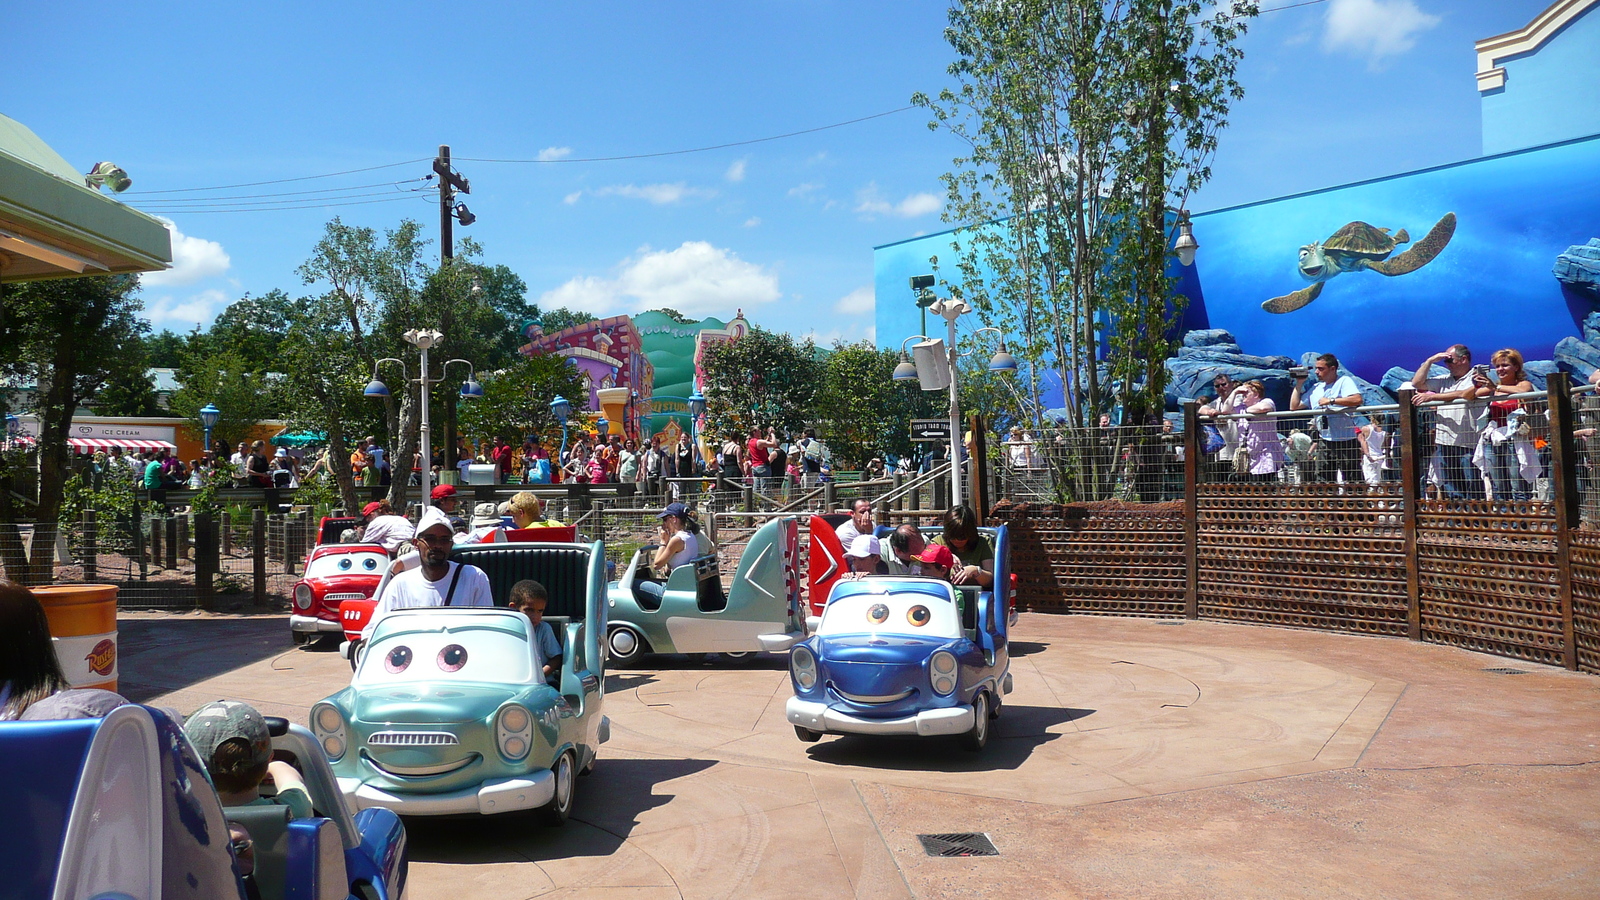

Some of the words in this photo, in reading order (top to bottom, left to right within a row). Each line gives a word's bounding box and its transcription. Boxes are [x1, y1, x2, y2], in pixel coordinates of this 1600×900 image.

[637, 325, 670, 337] TOON
[671, 328, 697, 338] TOW
[663, 401, 689, 411] STUDI
